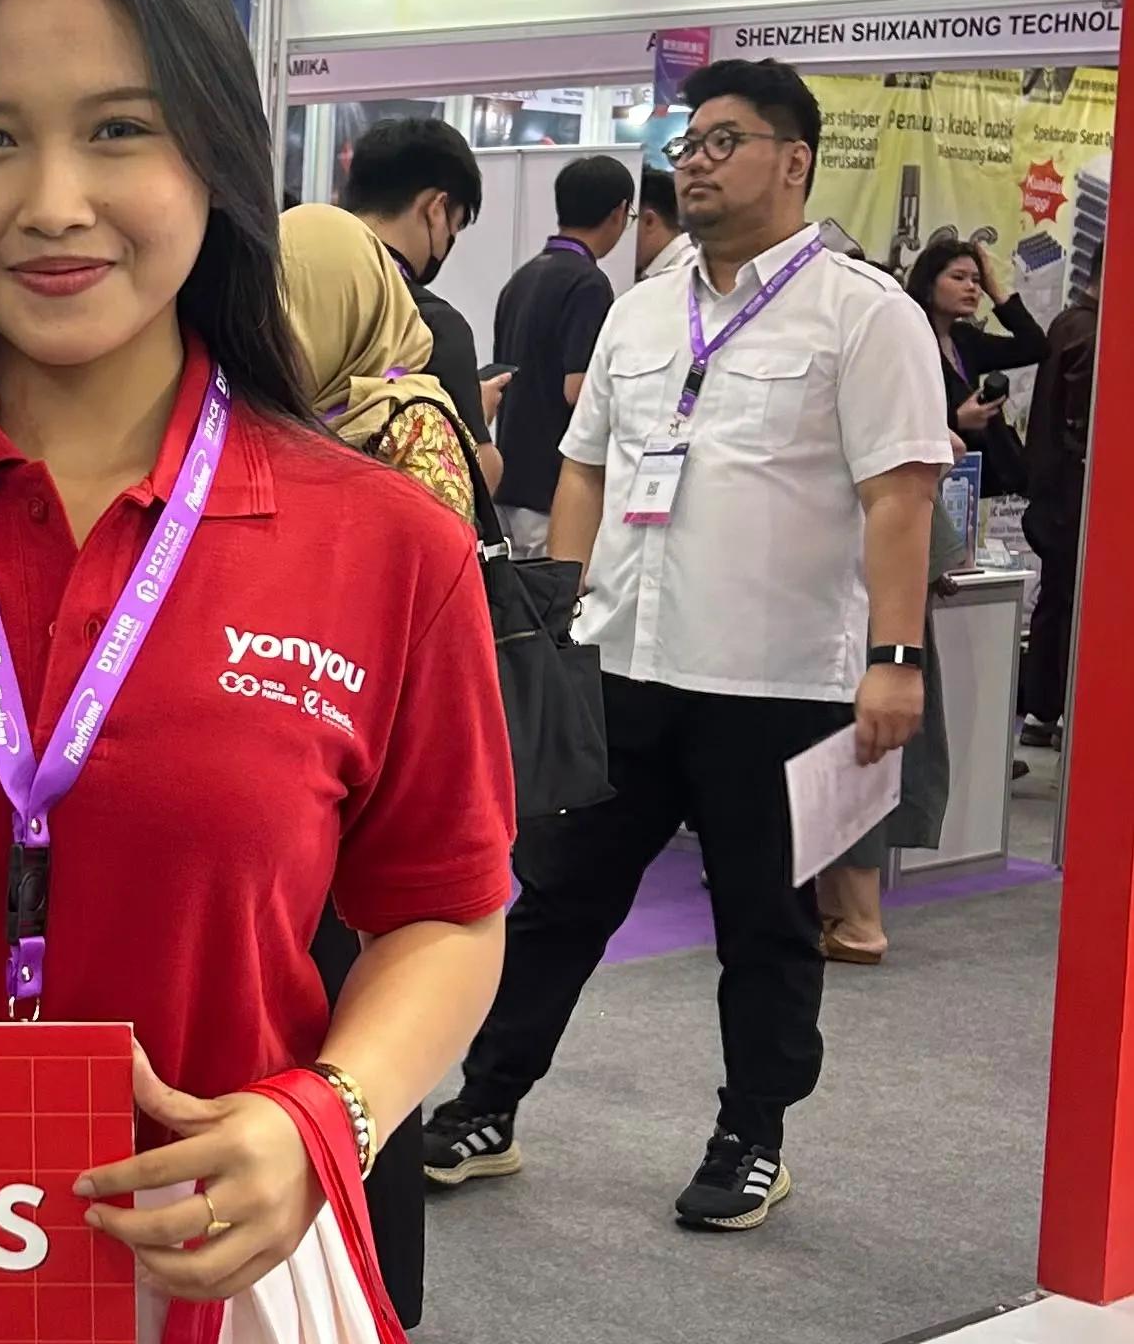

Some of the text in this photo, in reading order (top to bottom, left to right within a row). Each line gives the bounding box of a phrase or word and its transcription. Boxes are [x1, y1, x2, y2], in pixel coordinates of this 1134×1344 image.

[735, 9, 1121, 49] SHENZHEN SHIXIANTONG TECHNOL
[96, 613, 136, 673] DTI-HR
[224, 625, 366, 693] yonyou
[63, 699, 103, 765] FiberHome
